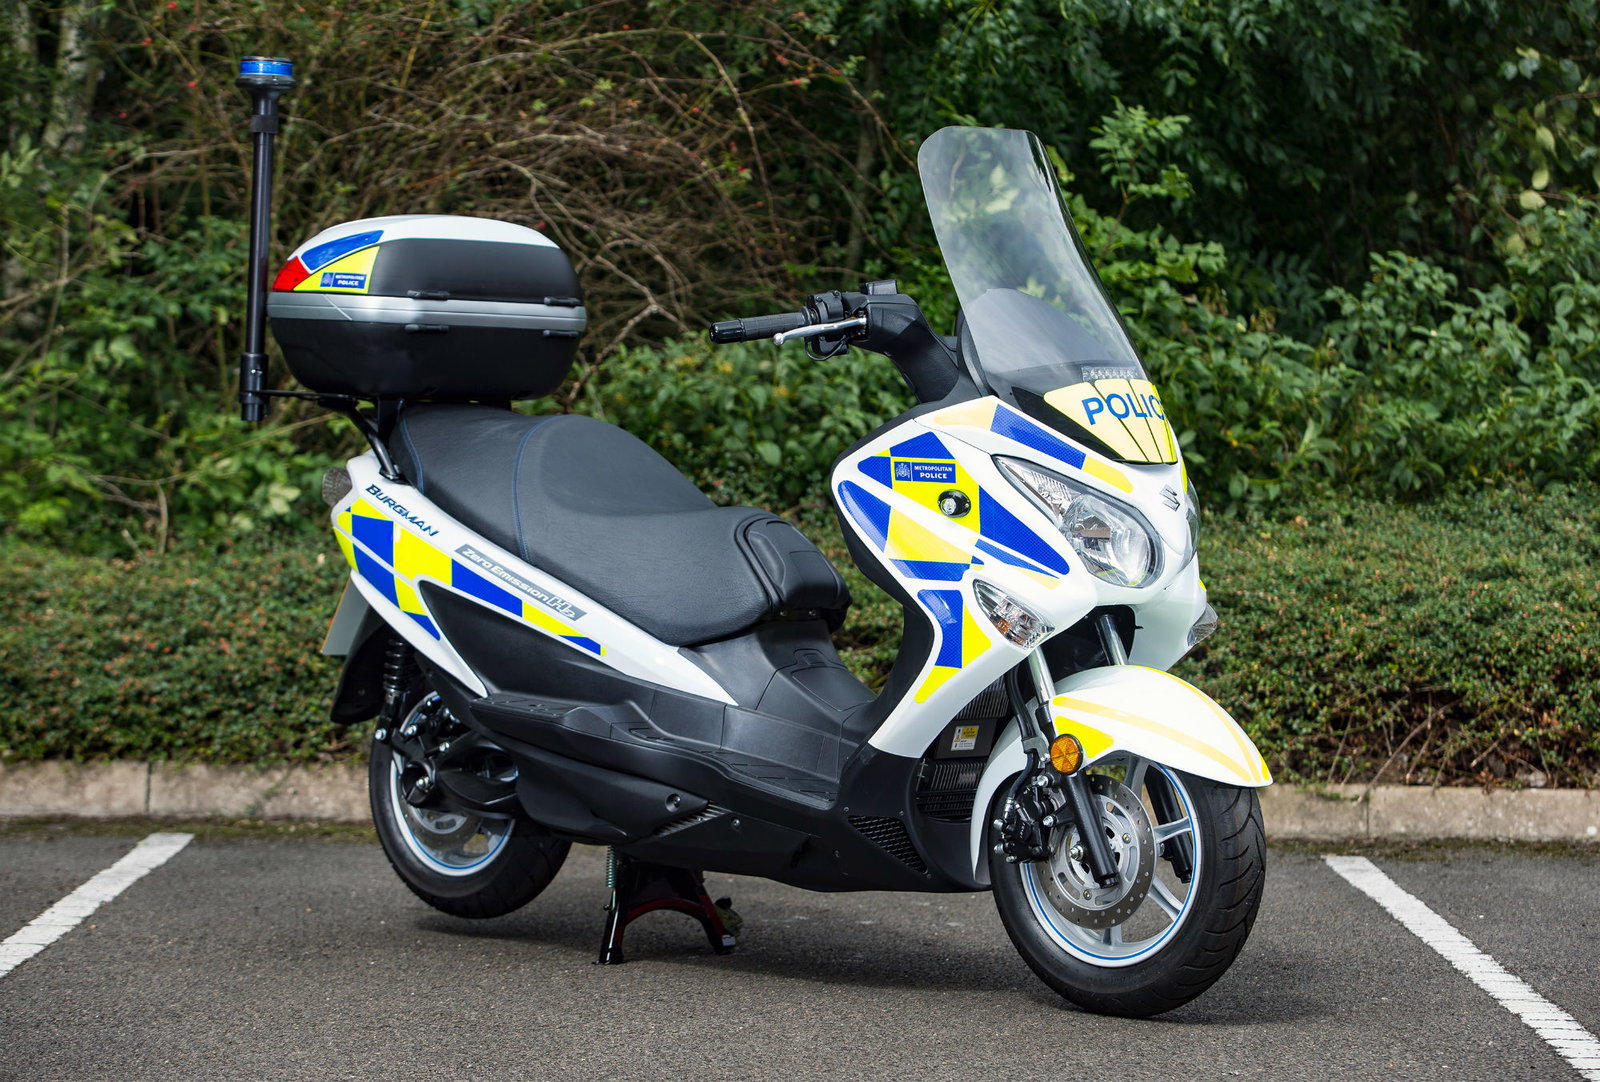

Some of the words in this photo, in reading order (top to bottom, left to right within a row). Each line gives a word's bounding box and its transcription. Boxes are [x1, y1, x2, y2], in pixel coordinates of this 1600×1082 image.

[1082, 393, 1165, 425] POLIC
[365, 484, 440, 537] BURGMAN
[462, 548, 491, 569] Zero
[490, 565, 549, 602] Emission
